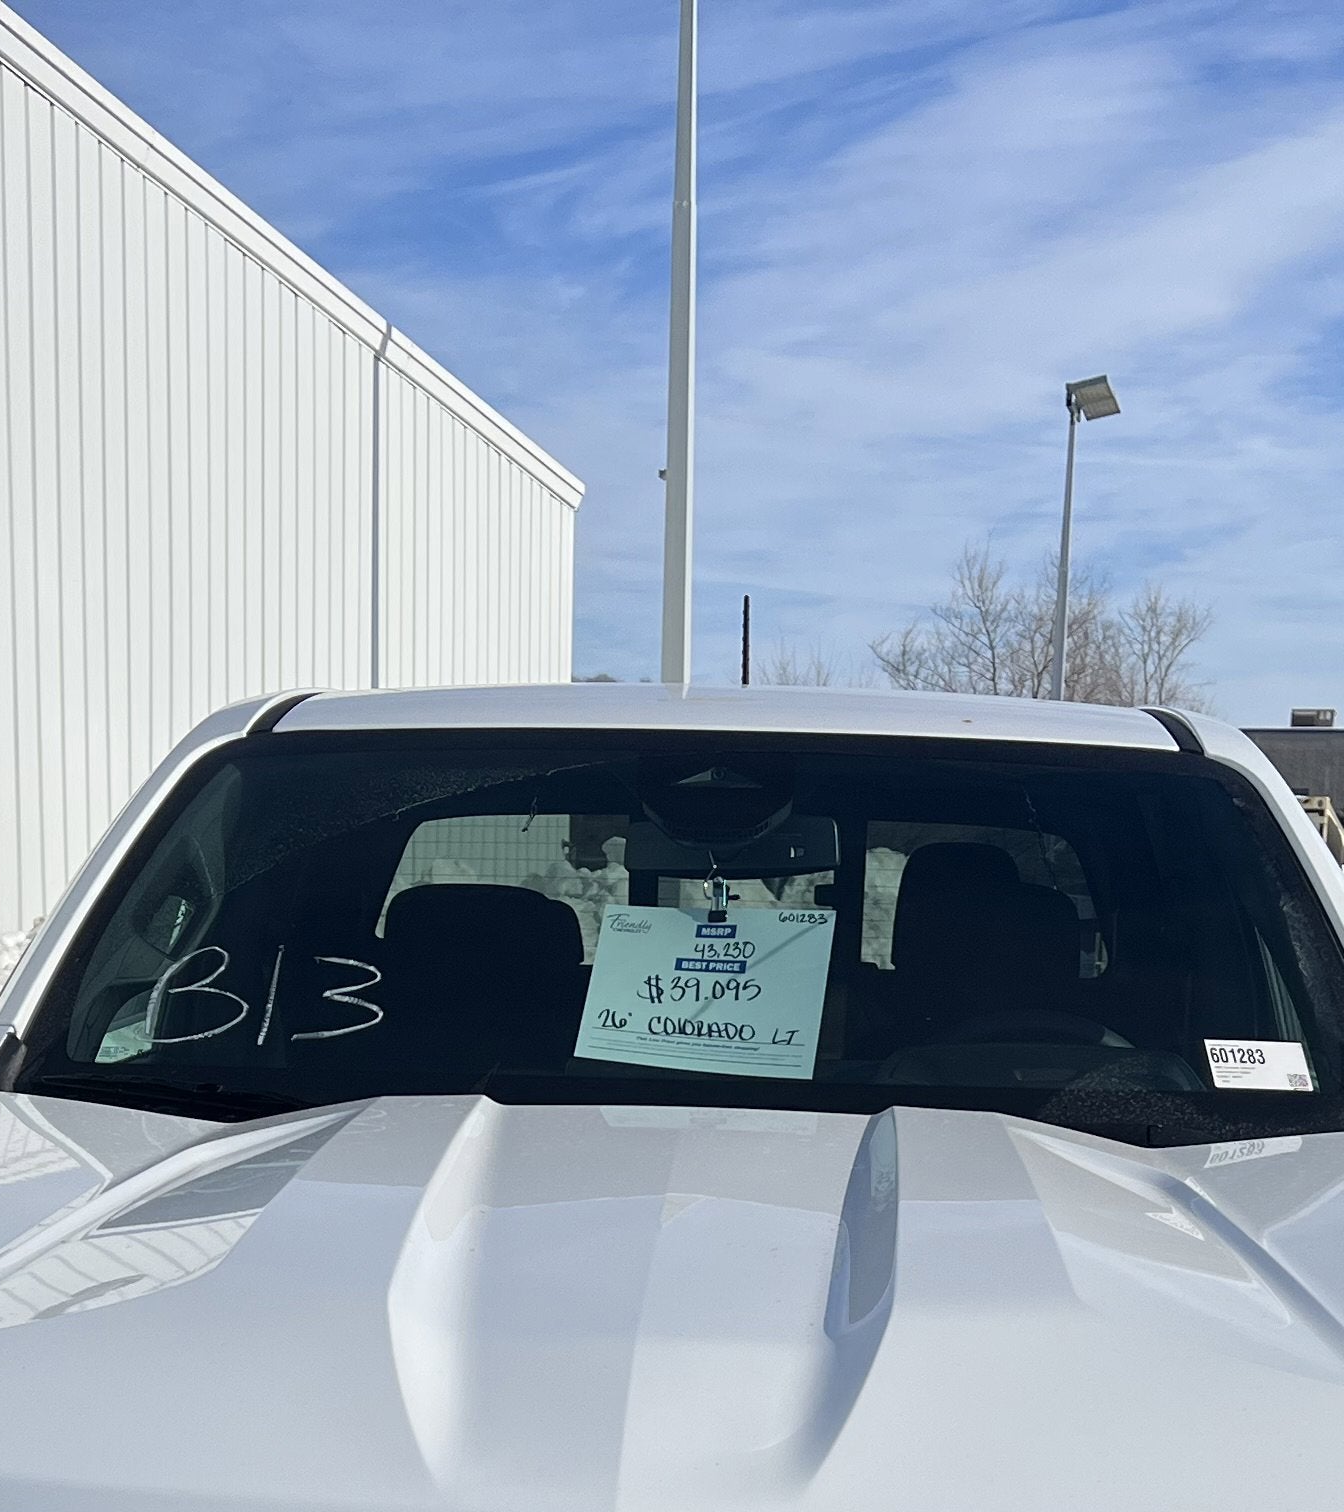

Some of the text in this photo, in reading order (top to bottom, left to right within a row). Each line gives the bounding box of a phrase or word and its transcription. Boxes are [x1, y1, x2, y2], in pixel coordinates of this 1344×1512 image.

[606, 913, 653, 934] Friendly
[778, 911, 828, 925] 601283
[700, 927, 732, 936] MSRP
[681, 960, 741, 971] BEST PRICE
[772, 1027, 800, 1045] LT
[1209, 1047, 1266, 1064] 601283
